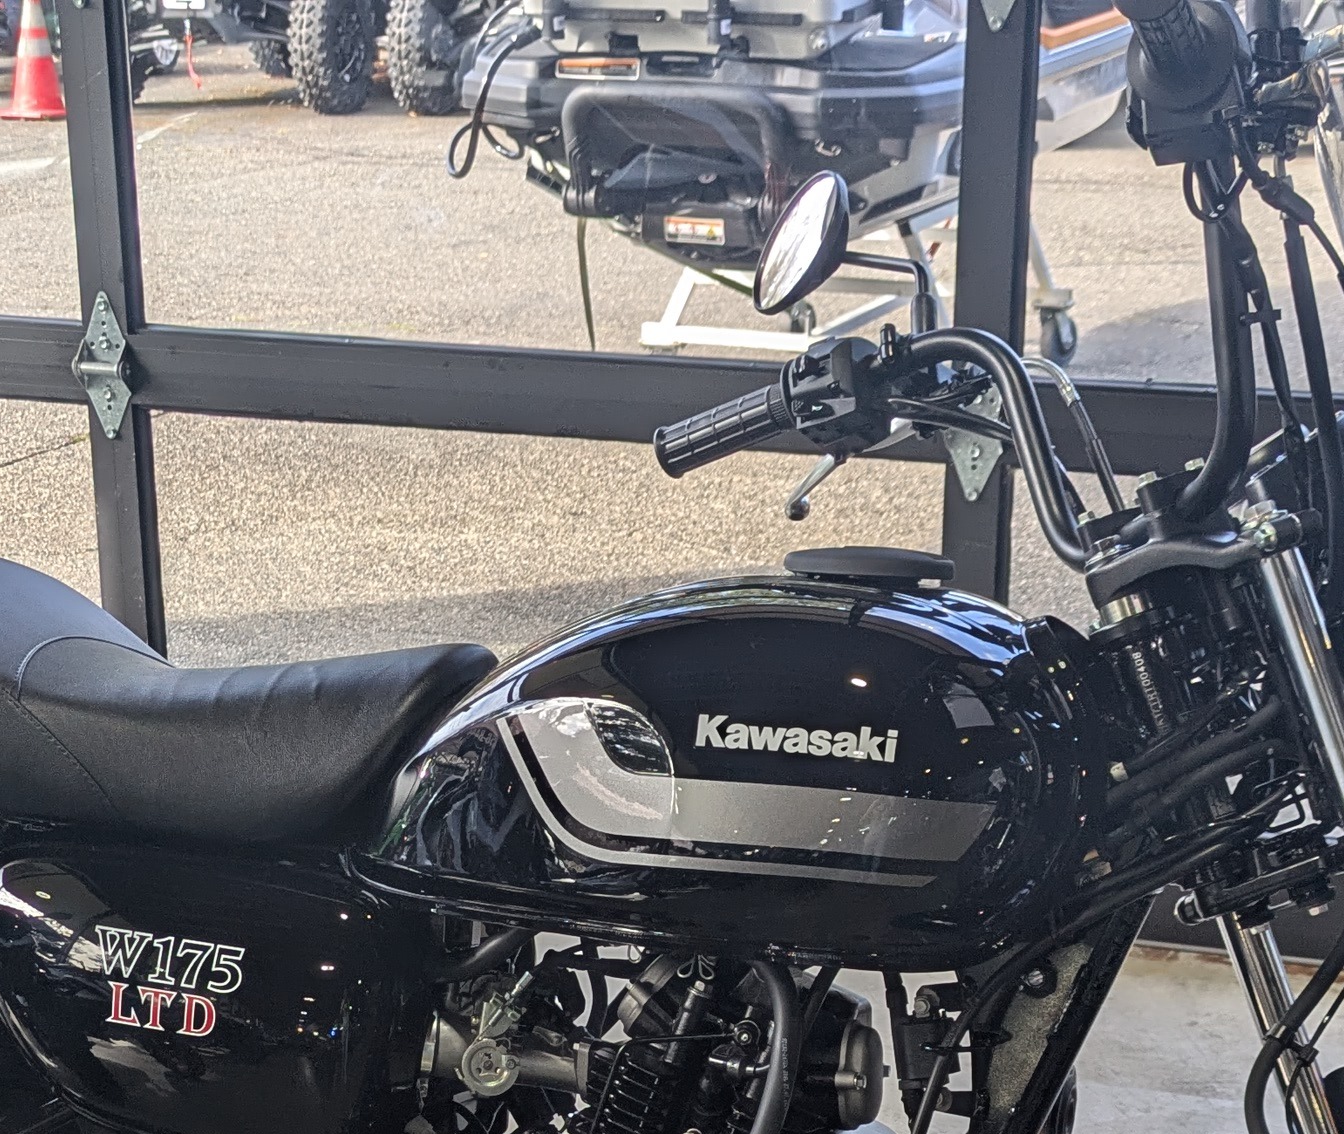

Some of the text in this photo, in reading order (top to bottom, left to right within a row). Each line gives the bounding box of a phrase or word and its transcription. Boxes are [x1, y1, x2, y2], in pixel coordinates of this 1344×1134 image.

[694, 713, 900, 764] Kawasaki
[94, 923, 247, 995] W175
[104, 980, 217, 1038] LTD
